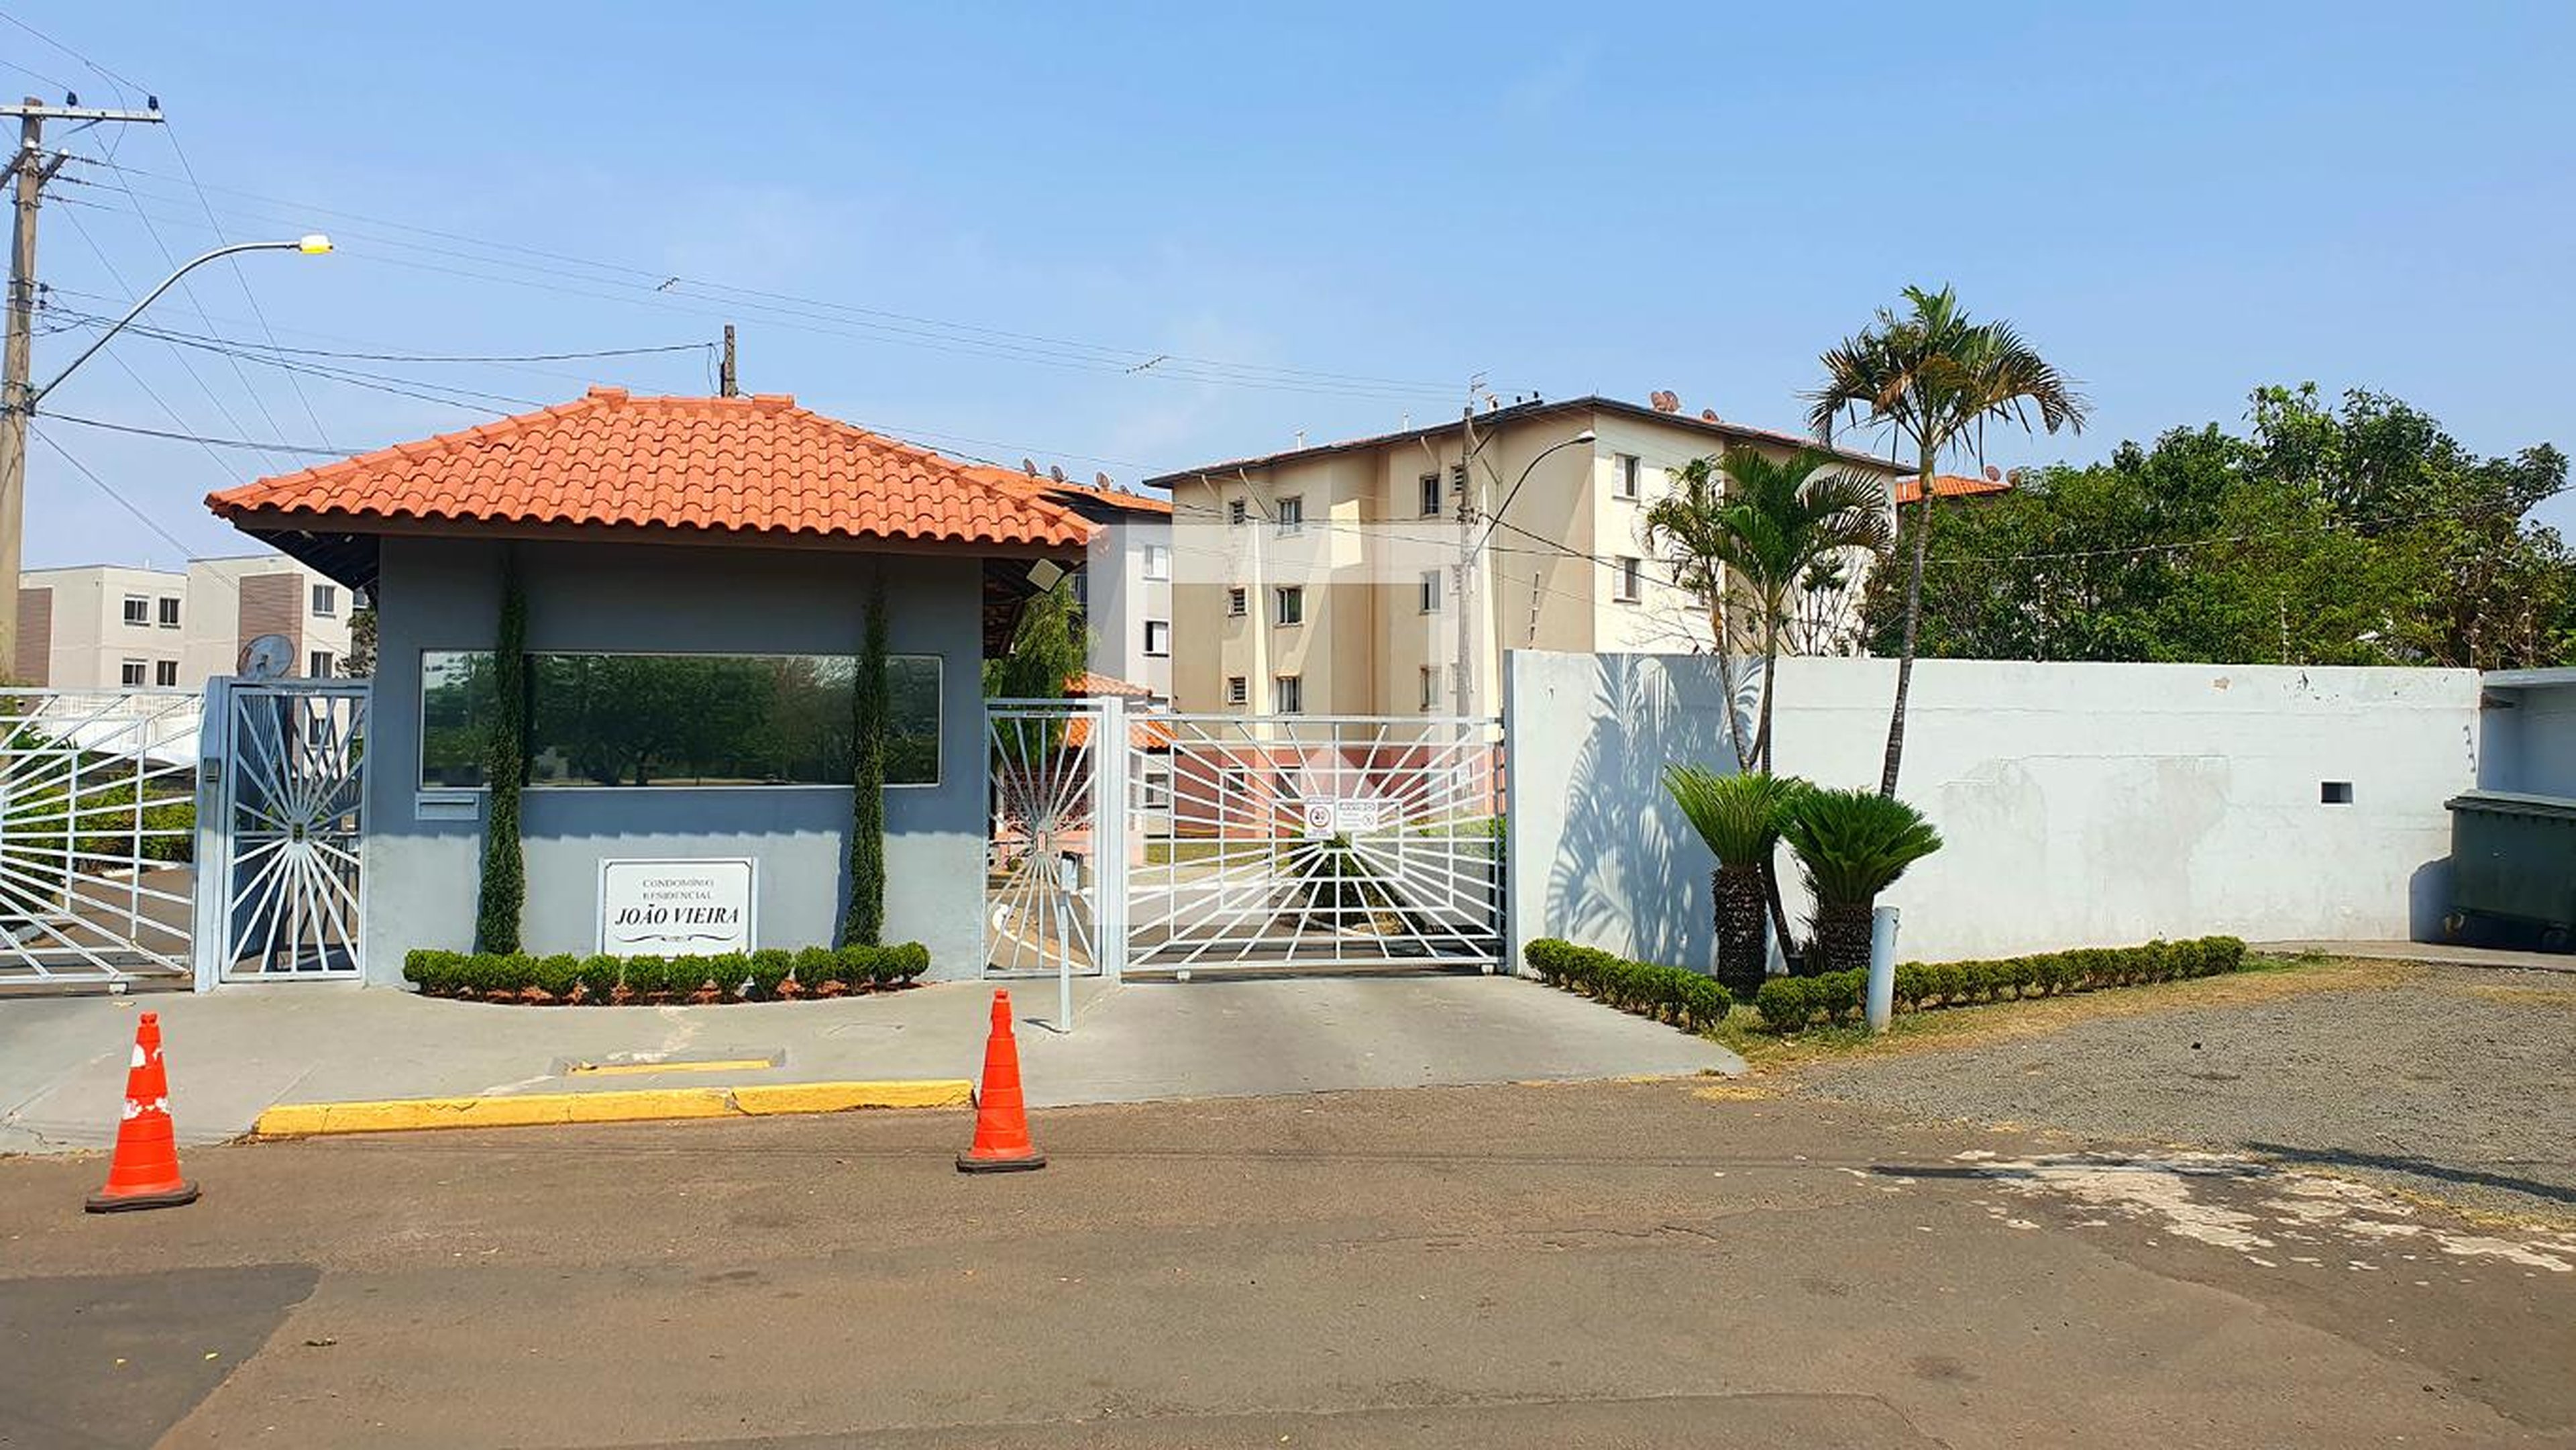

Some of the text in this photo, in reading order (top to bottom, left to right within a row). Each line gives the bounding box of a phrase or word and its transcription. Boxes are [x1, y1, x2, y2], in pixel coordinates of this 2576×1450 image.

[642, 890, 712, 900] RESIDENCIAL
[614, 903, 739, 925] JOÃO VIEIRA
